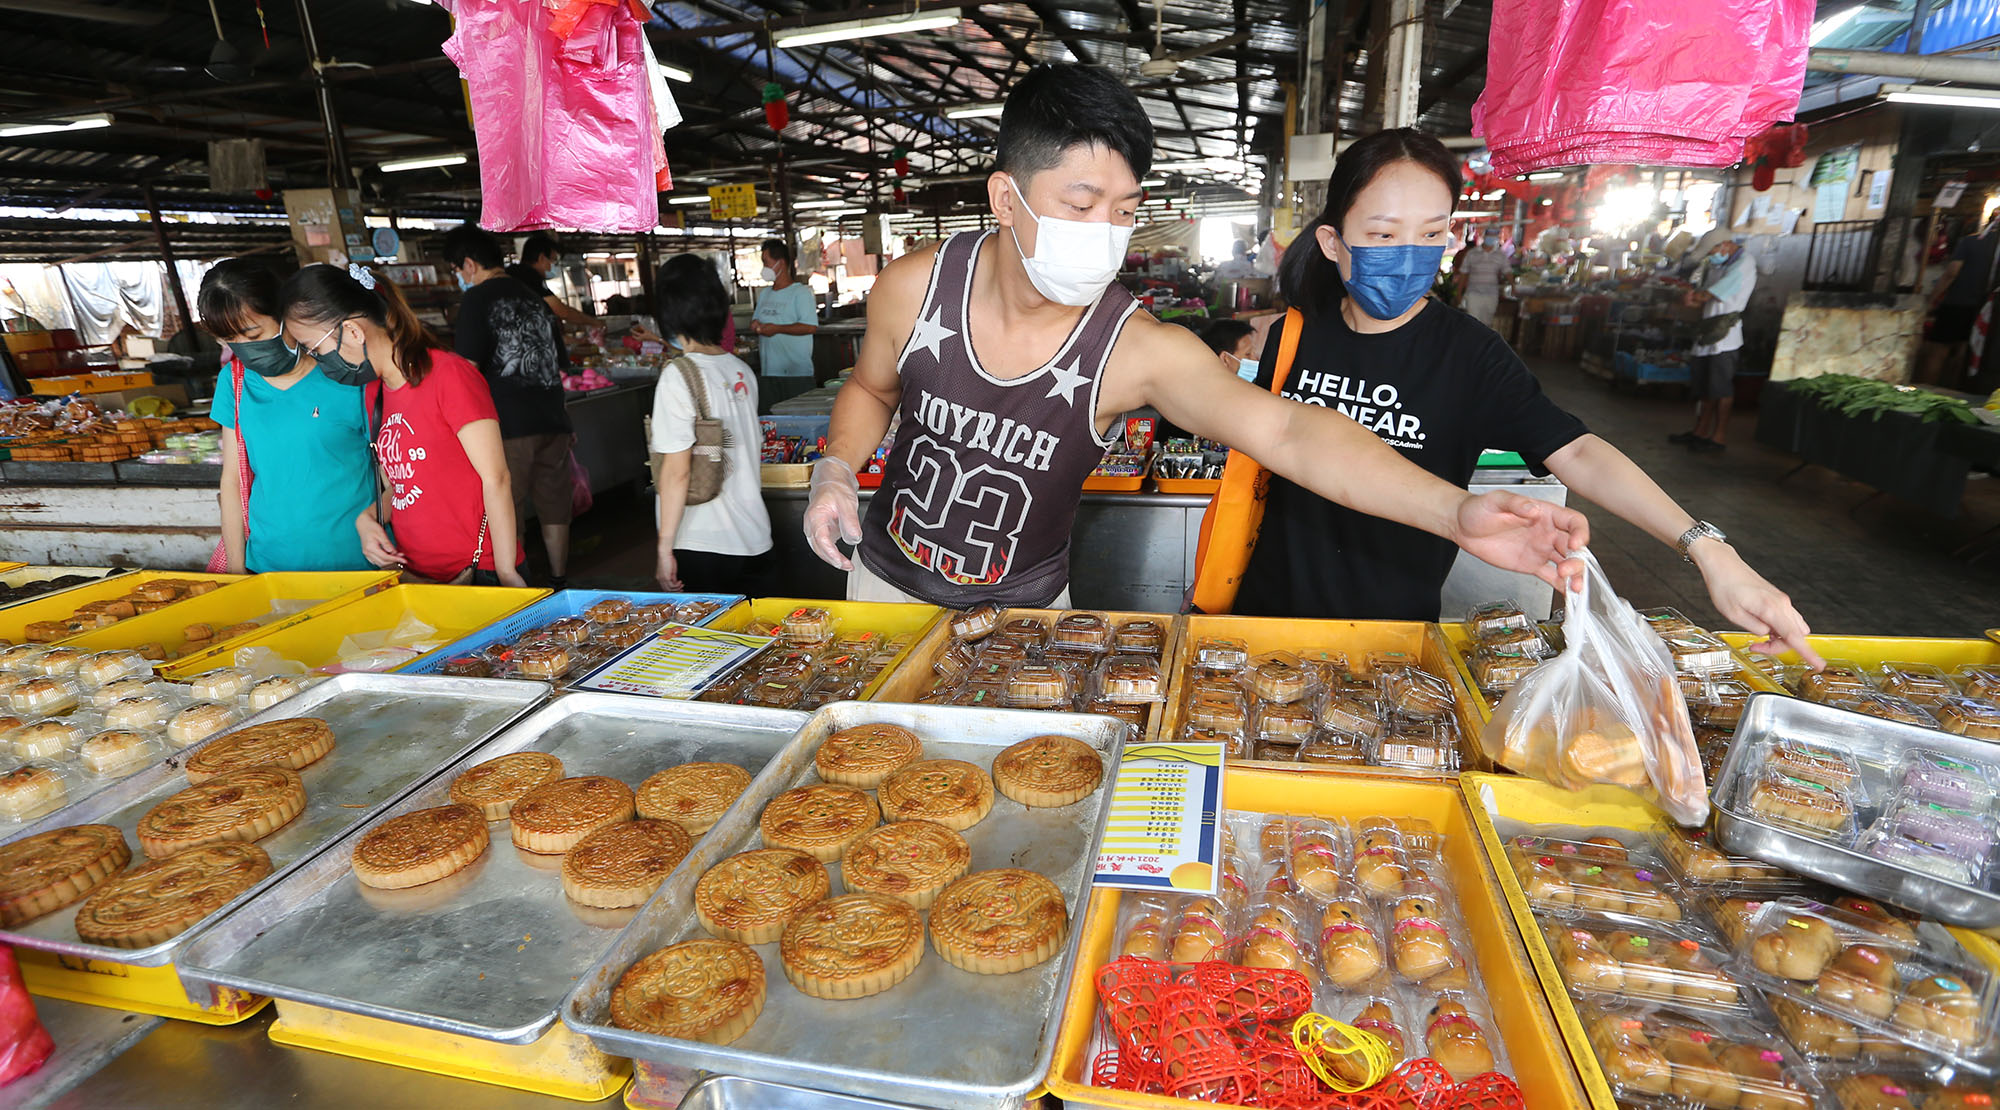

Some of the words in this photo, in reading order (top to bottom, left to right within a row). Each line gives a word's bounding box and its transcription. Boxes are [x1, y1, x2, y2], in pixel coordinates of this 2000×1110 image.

[1297, 369, 1402, 410] HELLO.
[914, 389, 1060, 471] JOYRICH
[408, 446, 427, 461] 99
[392, 485, 424, 511] AMPION
[886, 434, 1033, 586] 23
